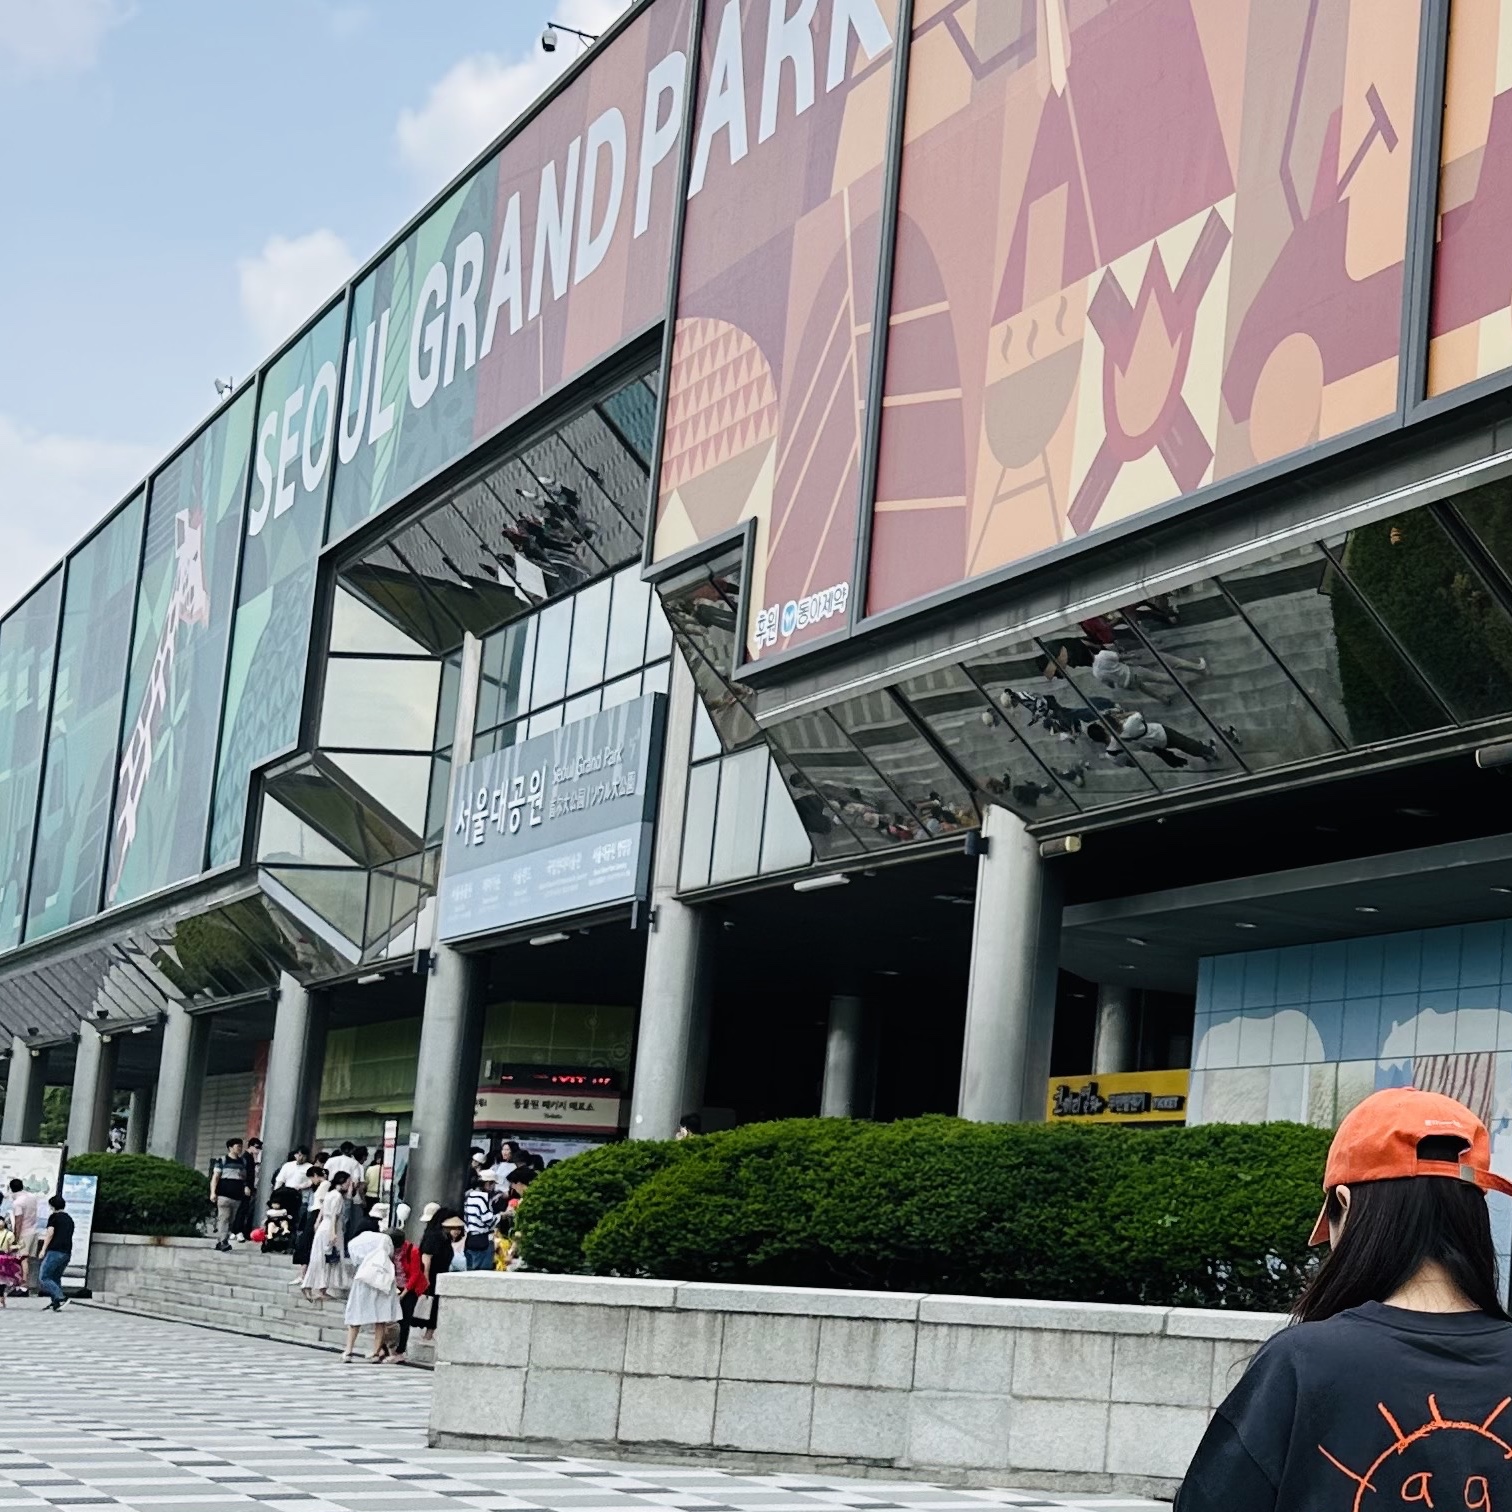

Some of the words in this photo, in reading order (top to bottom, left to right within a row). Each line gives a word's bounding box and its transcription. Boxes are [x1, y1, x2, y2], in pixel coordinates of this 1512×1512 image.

[248, 307, 396, 536] SEOUL
[408, 106, 627, 409] GRAND
[754, 604, 779, 648] 후원
[797, 582, 849, 629] 동아제약
[576, 749, 603, 778] Grand
[604, 743, 625, 768] Park
[455, 762, 547, 847] 서울대공원
